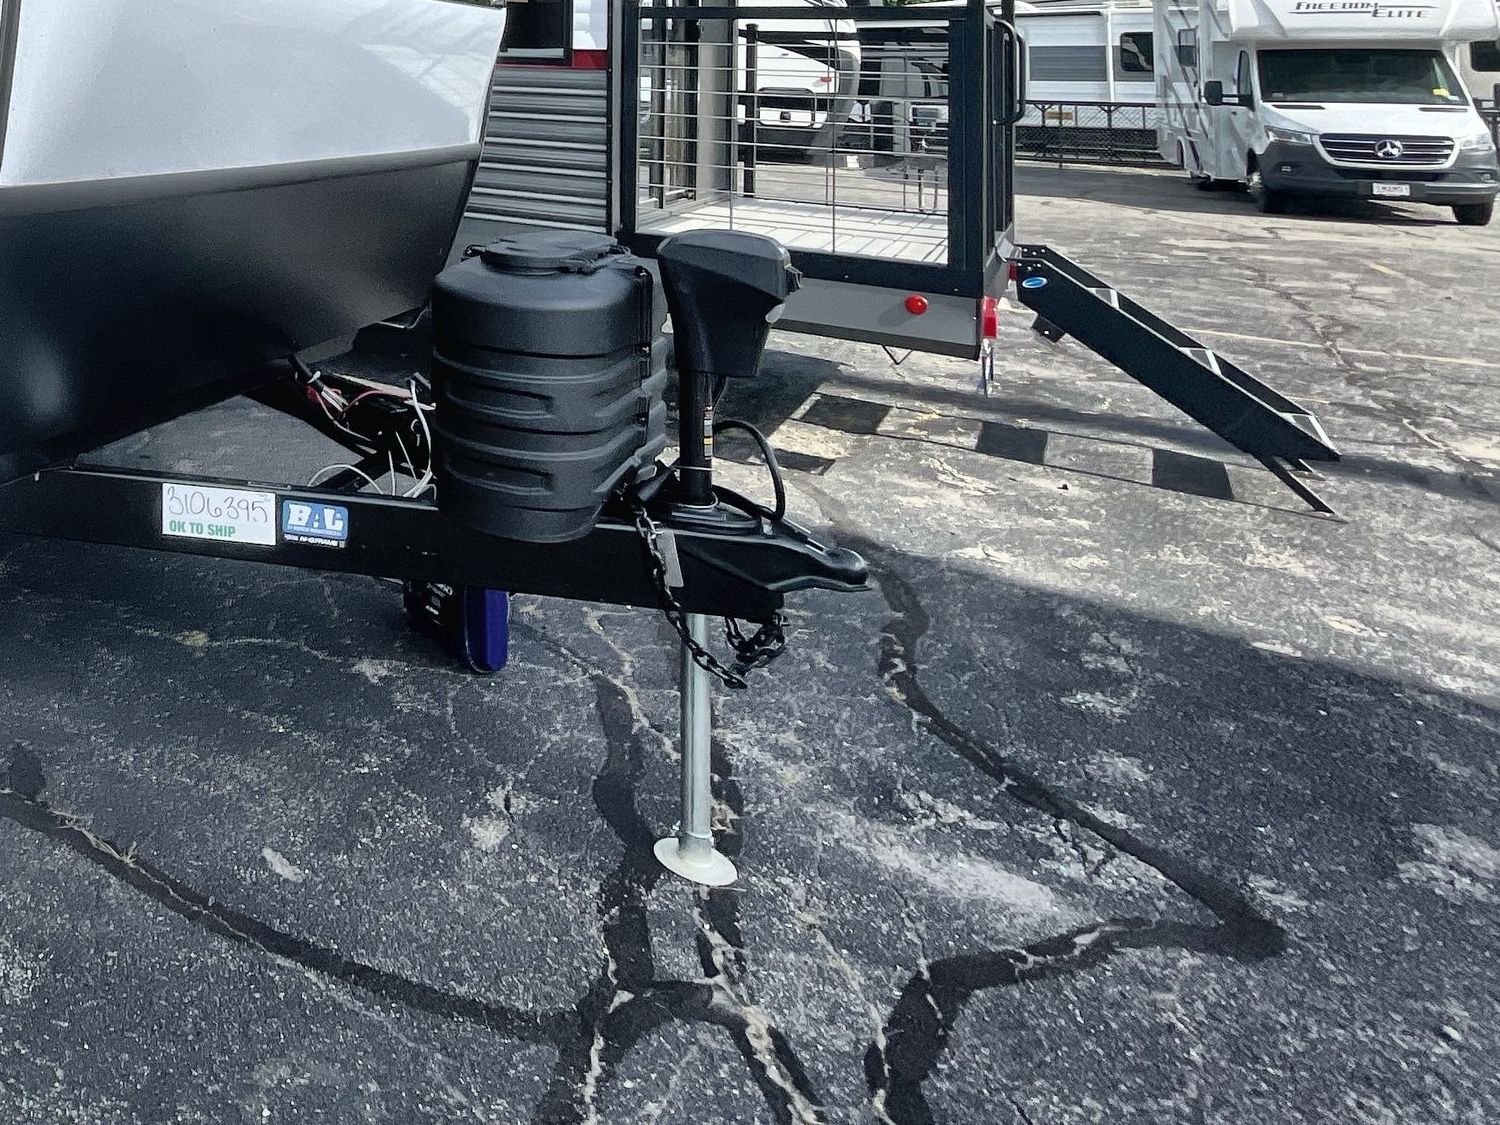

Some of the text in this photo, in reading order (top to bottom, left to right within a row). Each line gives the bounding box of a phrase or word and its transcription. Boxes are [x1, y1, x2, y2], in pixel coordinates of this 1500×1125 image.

[1295, 1, 1379, 10] FREEDOM
[1371, 8, 1429, 18] ELITE
[167, 486, 268, 523] 3106395
[287, 503, 344, 531] BAL
[169, 520, 236, 537] OK TO SHIP
